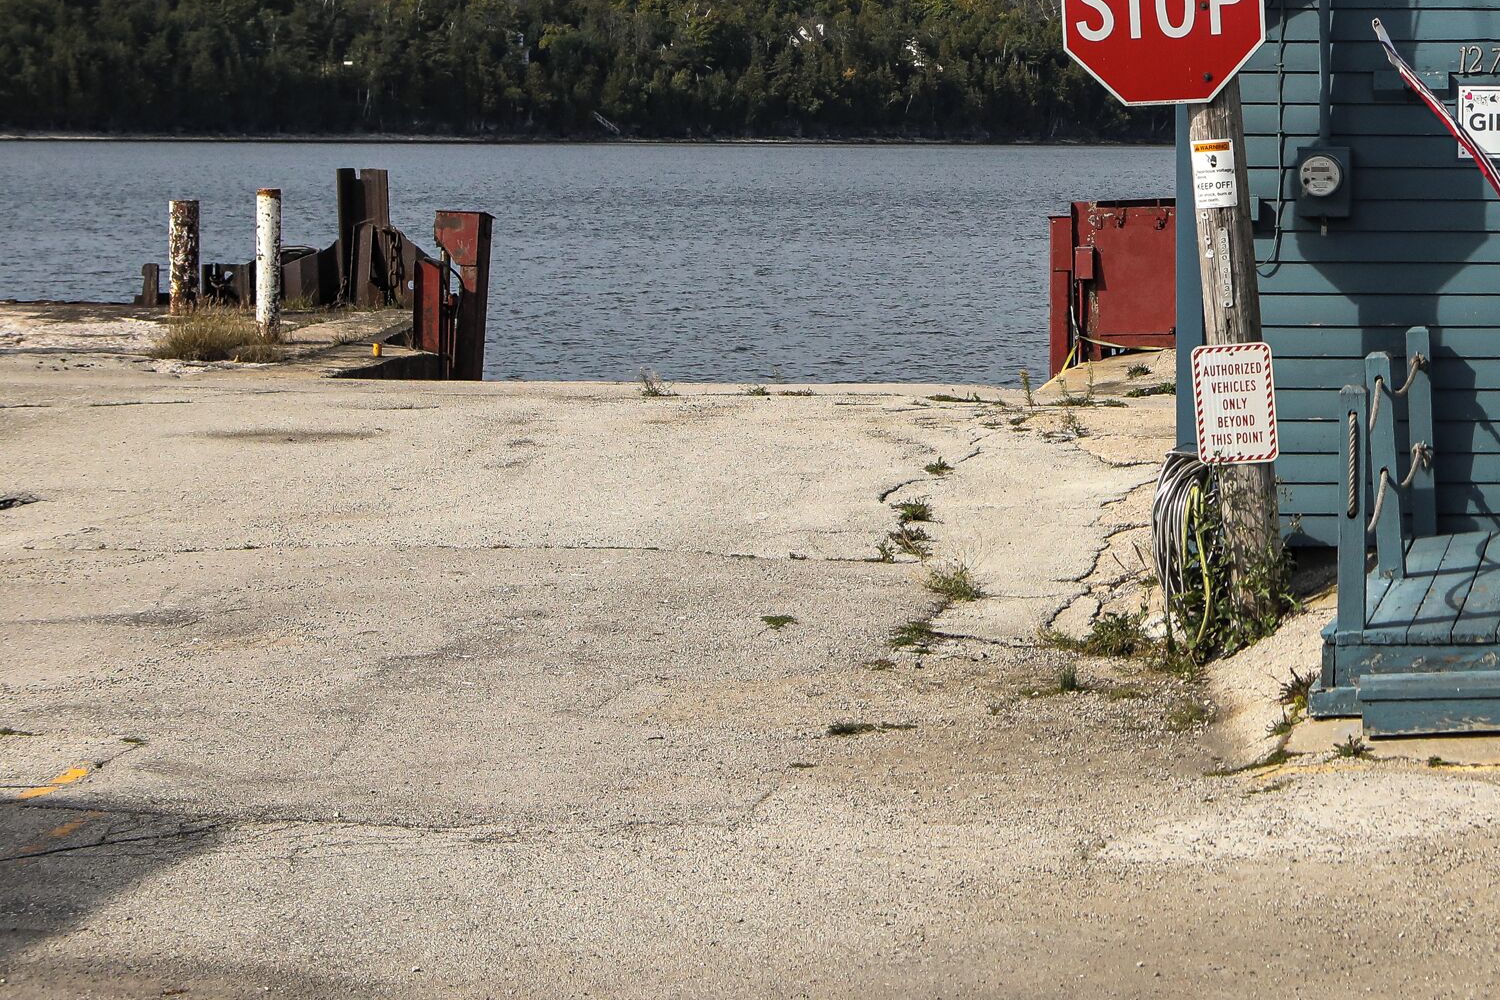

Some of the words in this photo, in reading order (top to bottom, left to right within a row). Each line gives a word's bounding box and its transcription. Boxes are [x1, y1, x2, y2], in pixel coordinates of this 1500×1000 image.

[1197, 182, 1213, 190] KEEP
[1215, 181, 1233, 190] OFF!
[1203, 362, 1262, 377] AUTHORIZED
[1211, 379, 1257, 394] VEHICLES
[1222, 396, 1248, 411] ONLY
[1217, 413, 1255, 428] BEYOND
[1211, 431, 1233, 446] THIS
[1235, 430, 1264, 444] POINT
